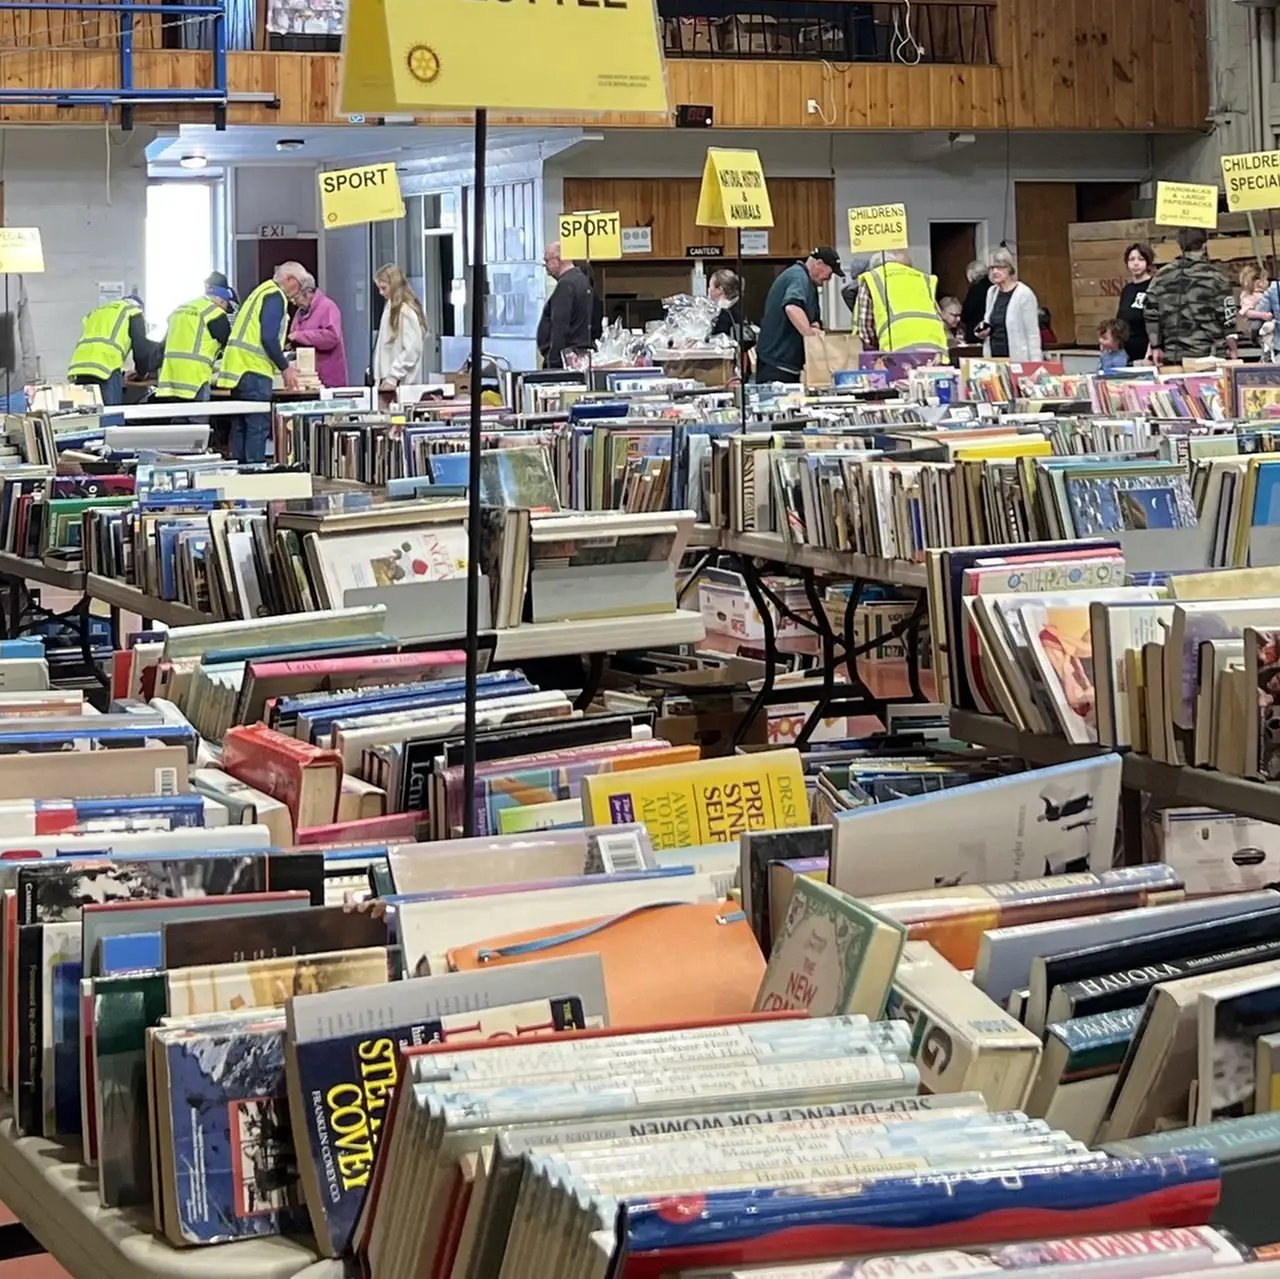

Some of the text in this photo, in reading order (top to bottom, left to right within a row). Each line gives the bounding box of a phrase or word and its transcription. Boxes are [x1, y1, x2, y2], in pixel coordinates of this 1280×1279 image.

[323, 168, 388, 193] SPORT
[730, 204, 761, 220] ANIMALS
[849, 206, 904, 221] CHILDRENS
[561, 218, 618, 237] SPORT
[854, 222, 903, 236] SPECIALS
[742, 780, 765, 832] PRE
[787, 972, 818, 1006] NEW
[1076, 962, 1183, 996] HAUORA
[312, 1090, 329, 1145] FRANKLIN
[629, 1114, 723, 1138] WOMEN
[327, 1082, 373, 1191] COVEY
[722, 1140, 828, 1158] Managing Pain
[739, 1156, 791, 1170] Natural
[755, 1170, 805, 1183] Health
[812, 1166, 840, 1177] And
[1053, 1228, 1204, 1263] MAXIMUM
